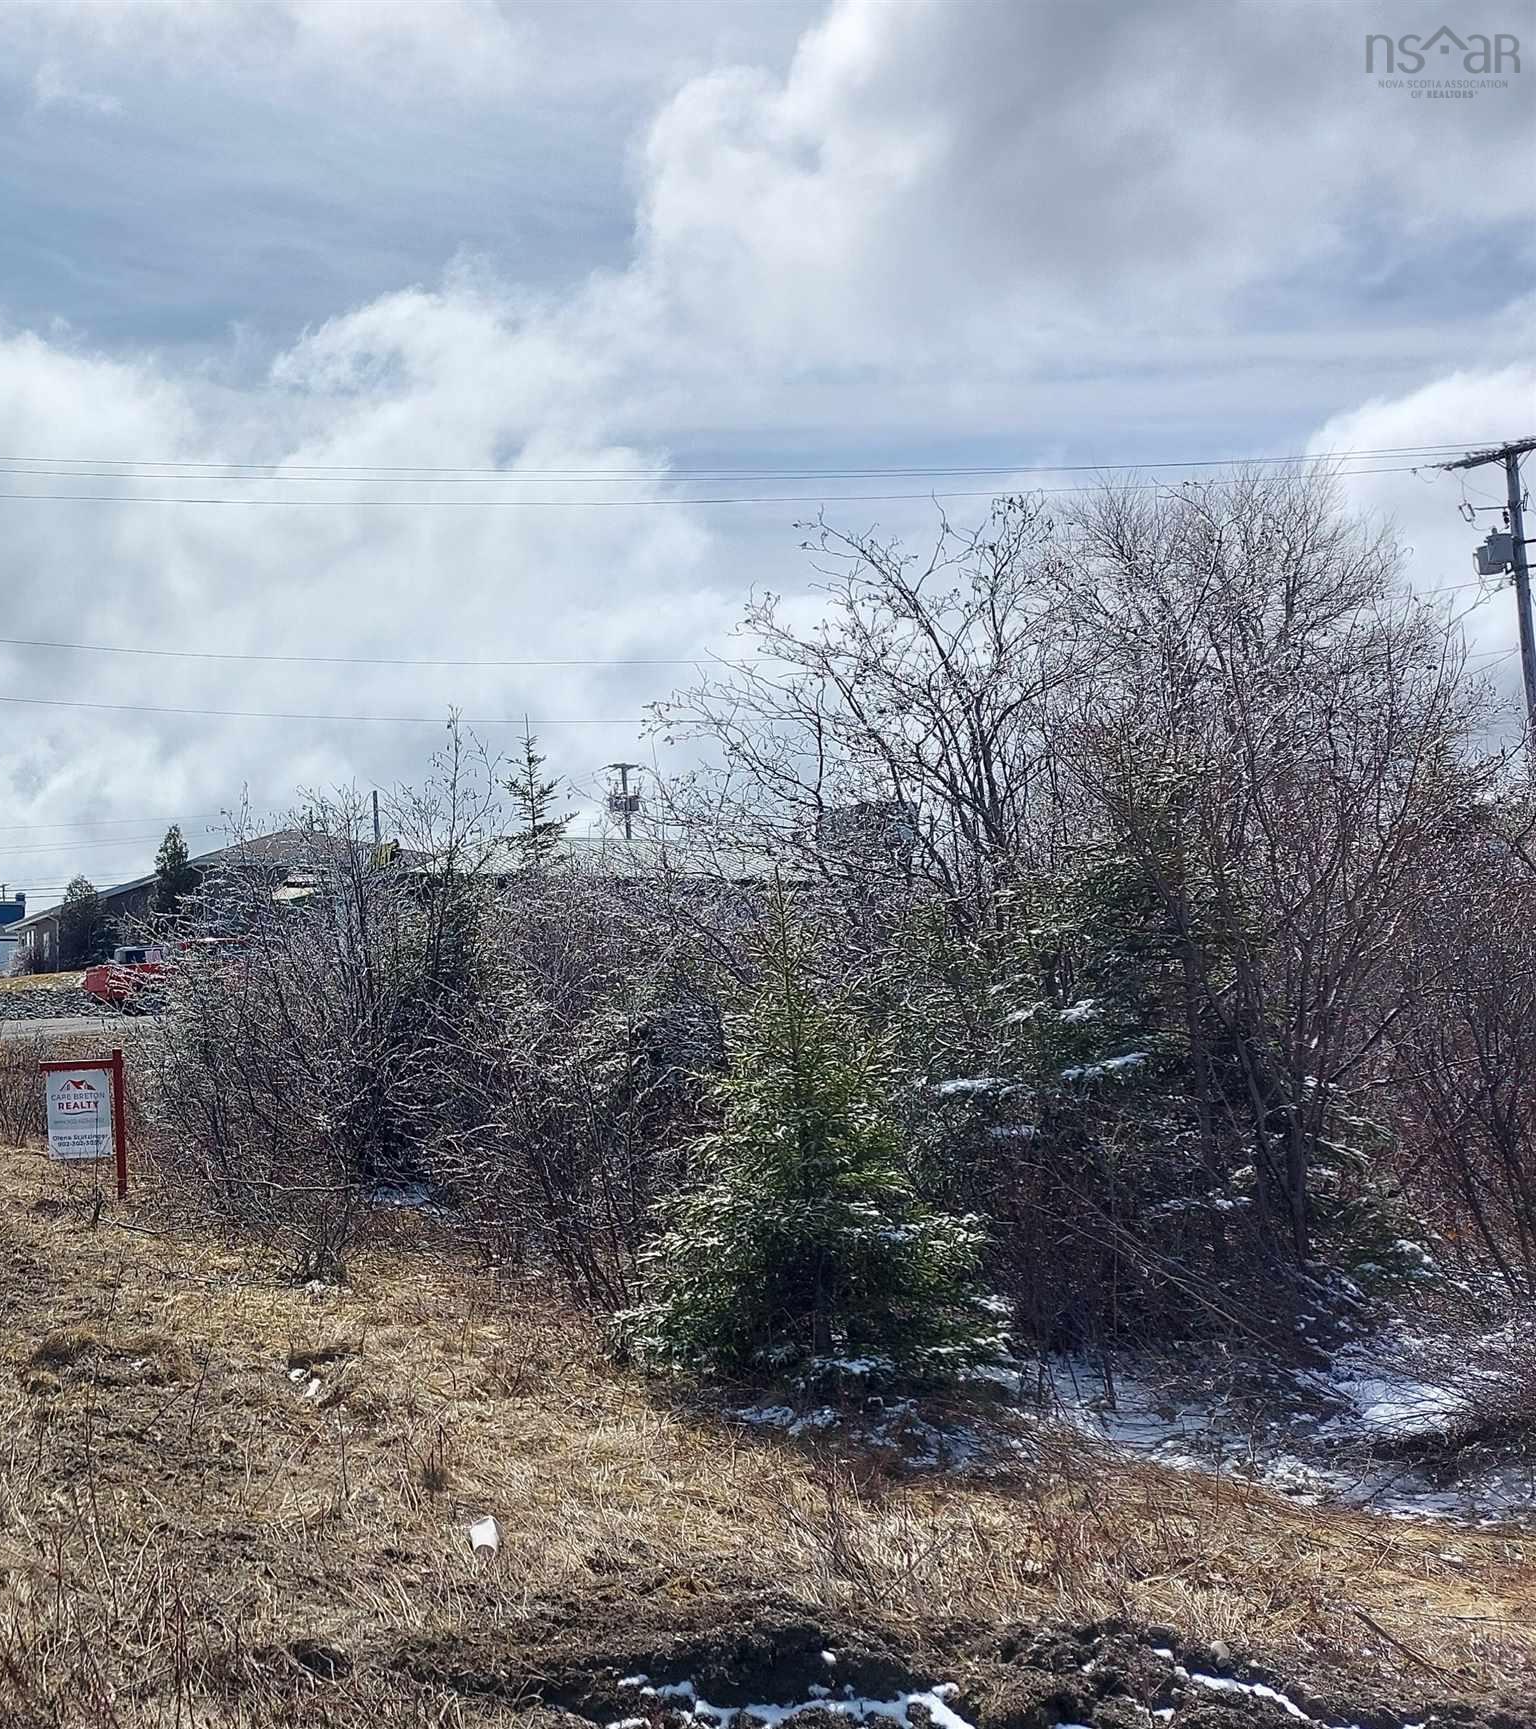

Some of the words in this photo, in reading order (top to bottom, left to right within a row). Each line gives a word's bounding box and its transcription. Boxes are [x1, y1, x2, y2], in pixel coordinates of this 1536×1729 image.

[50, 1093, 72, 1101] CAPE
[73, 1092, 105, 1100] BRETON
[57, 1100, 99, 1110] REALTY
